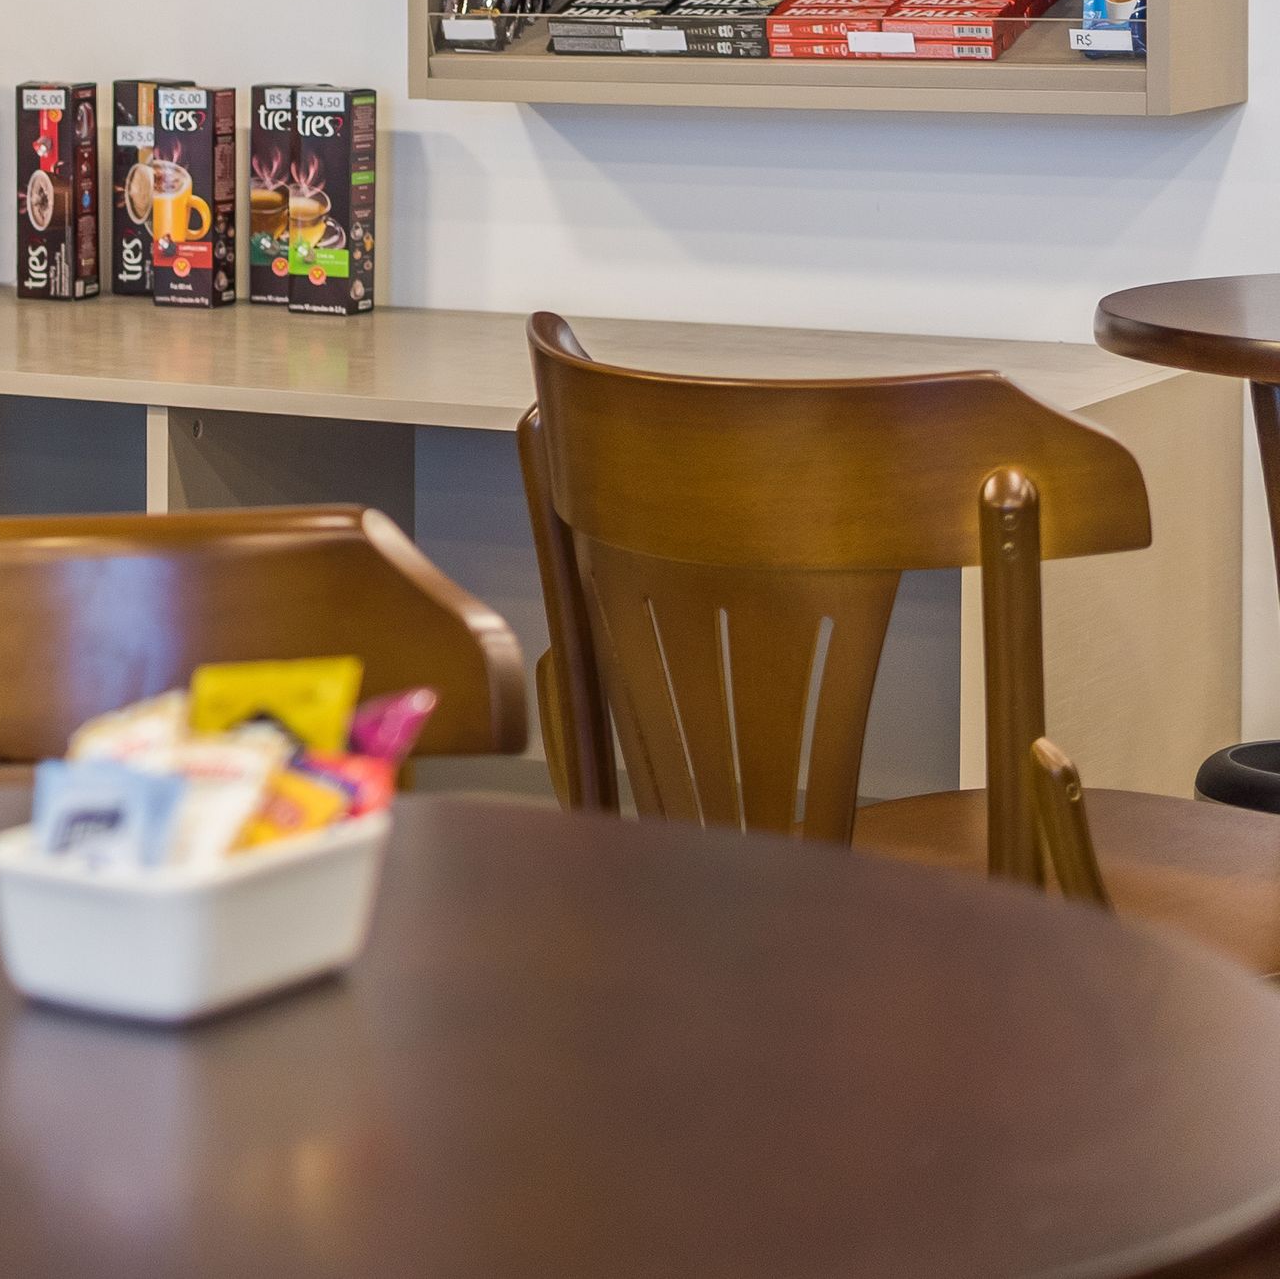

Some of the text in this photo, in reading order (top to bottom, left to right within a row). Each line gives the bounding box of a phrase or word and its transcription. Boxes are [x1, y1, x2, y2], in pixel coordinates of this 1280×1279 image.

[561, 7, 639, 16] HALLS
[672, 8, 739, 16] HALLS
[784, 8, 851, 16] HALLS
[894, 9, 977, 18] HALLS
[1076, 34, 1093, 47] R$
[26, 93, 63, 106] R$ 5,00
[162, 93, 201, 105] R$ 6,00
[269, 94, 282, 105] R$
[301, 96, 341, 109] R$ 4,50
[160, 108, 198, 132] tres
[296, 110, 335, 137] tres
[122, 131, 134, 142] R$
